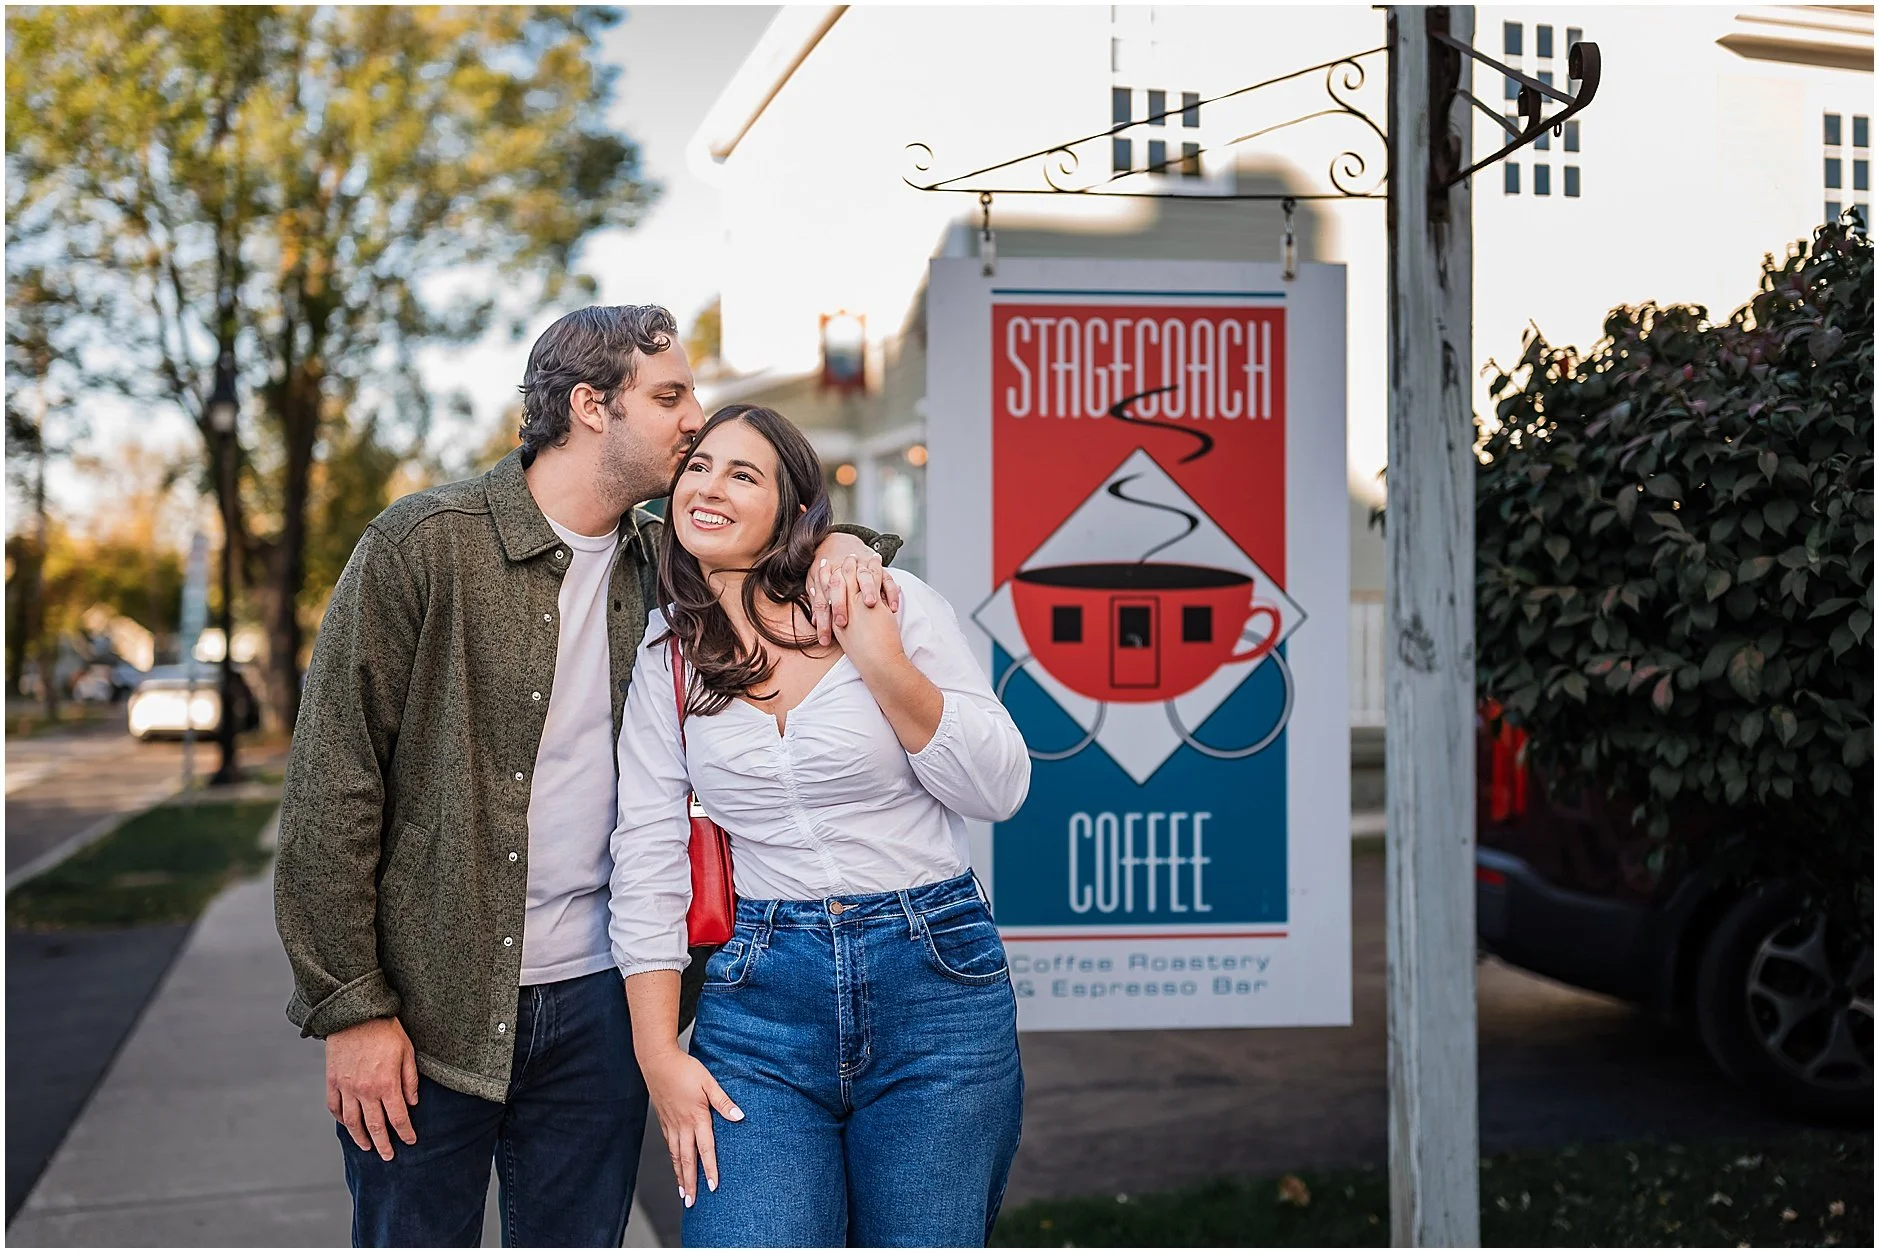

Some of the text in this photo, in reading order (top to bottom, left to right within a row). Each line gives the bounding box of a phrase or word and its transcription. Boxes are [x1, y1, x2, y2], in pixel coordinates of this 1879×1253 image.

[1006, 316, 1272, 420] STAGECOACH
[1069, 811, 1213, 913] COFFEE
[1012, 953, 1270, 974] Coffee Roastery
[1015, 976, 1268, 999] & Espresso Bar
